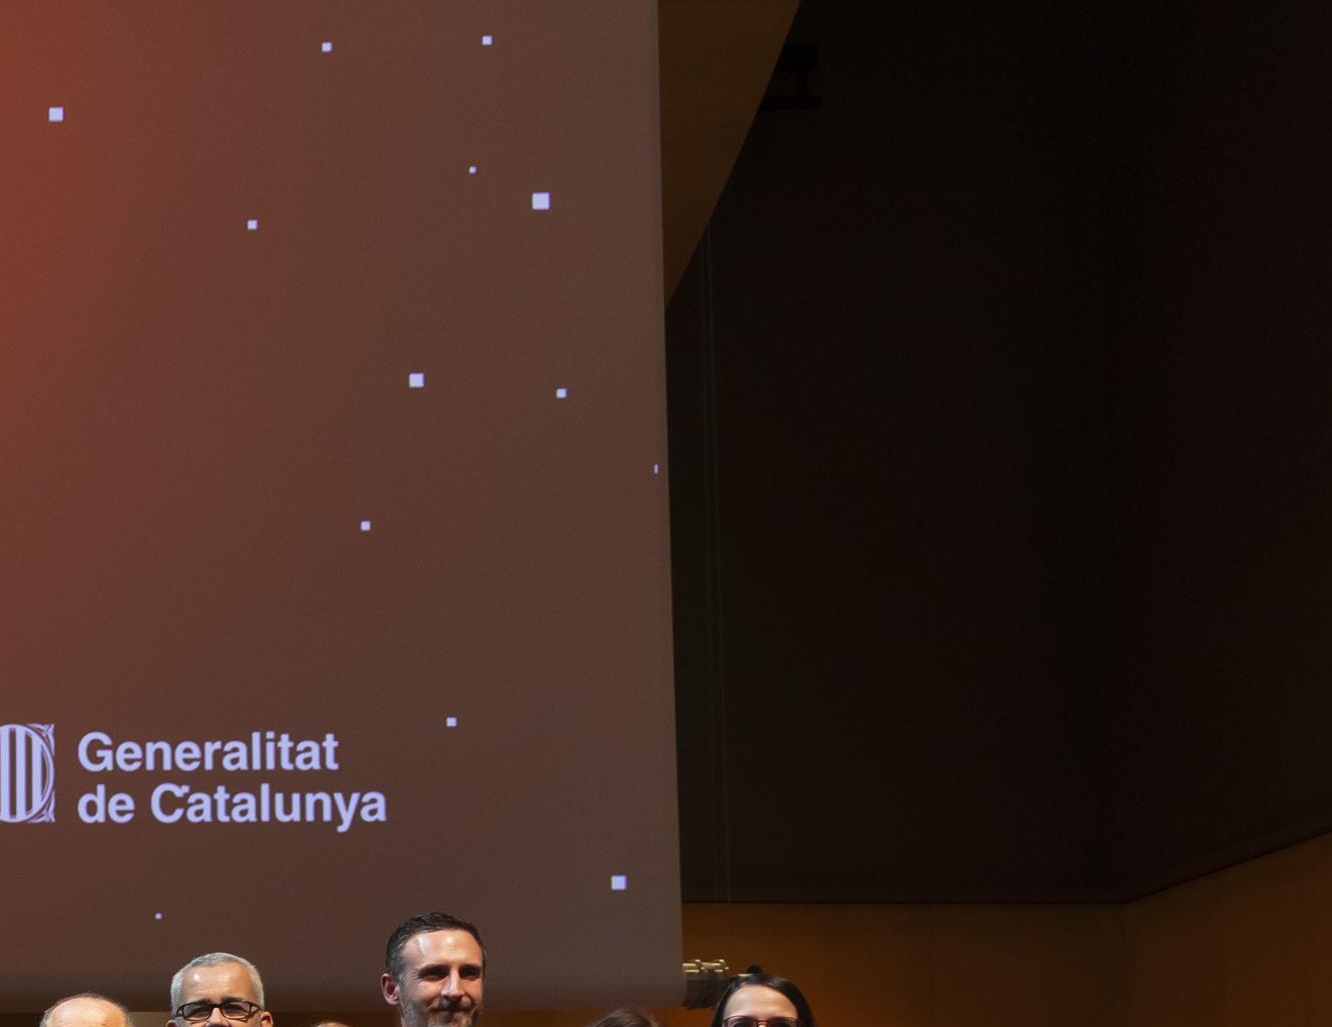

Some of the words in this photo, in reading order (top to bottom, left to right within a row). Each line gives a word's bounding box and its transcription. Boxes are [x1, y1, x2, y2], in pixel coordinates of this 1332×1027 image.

[77, 731, 340, 773] Generalitat
[77, 784, 136, 824] de
[150, 782, 388, 833] Catalunya
